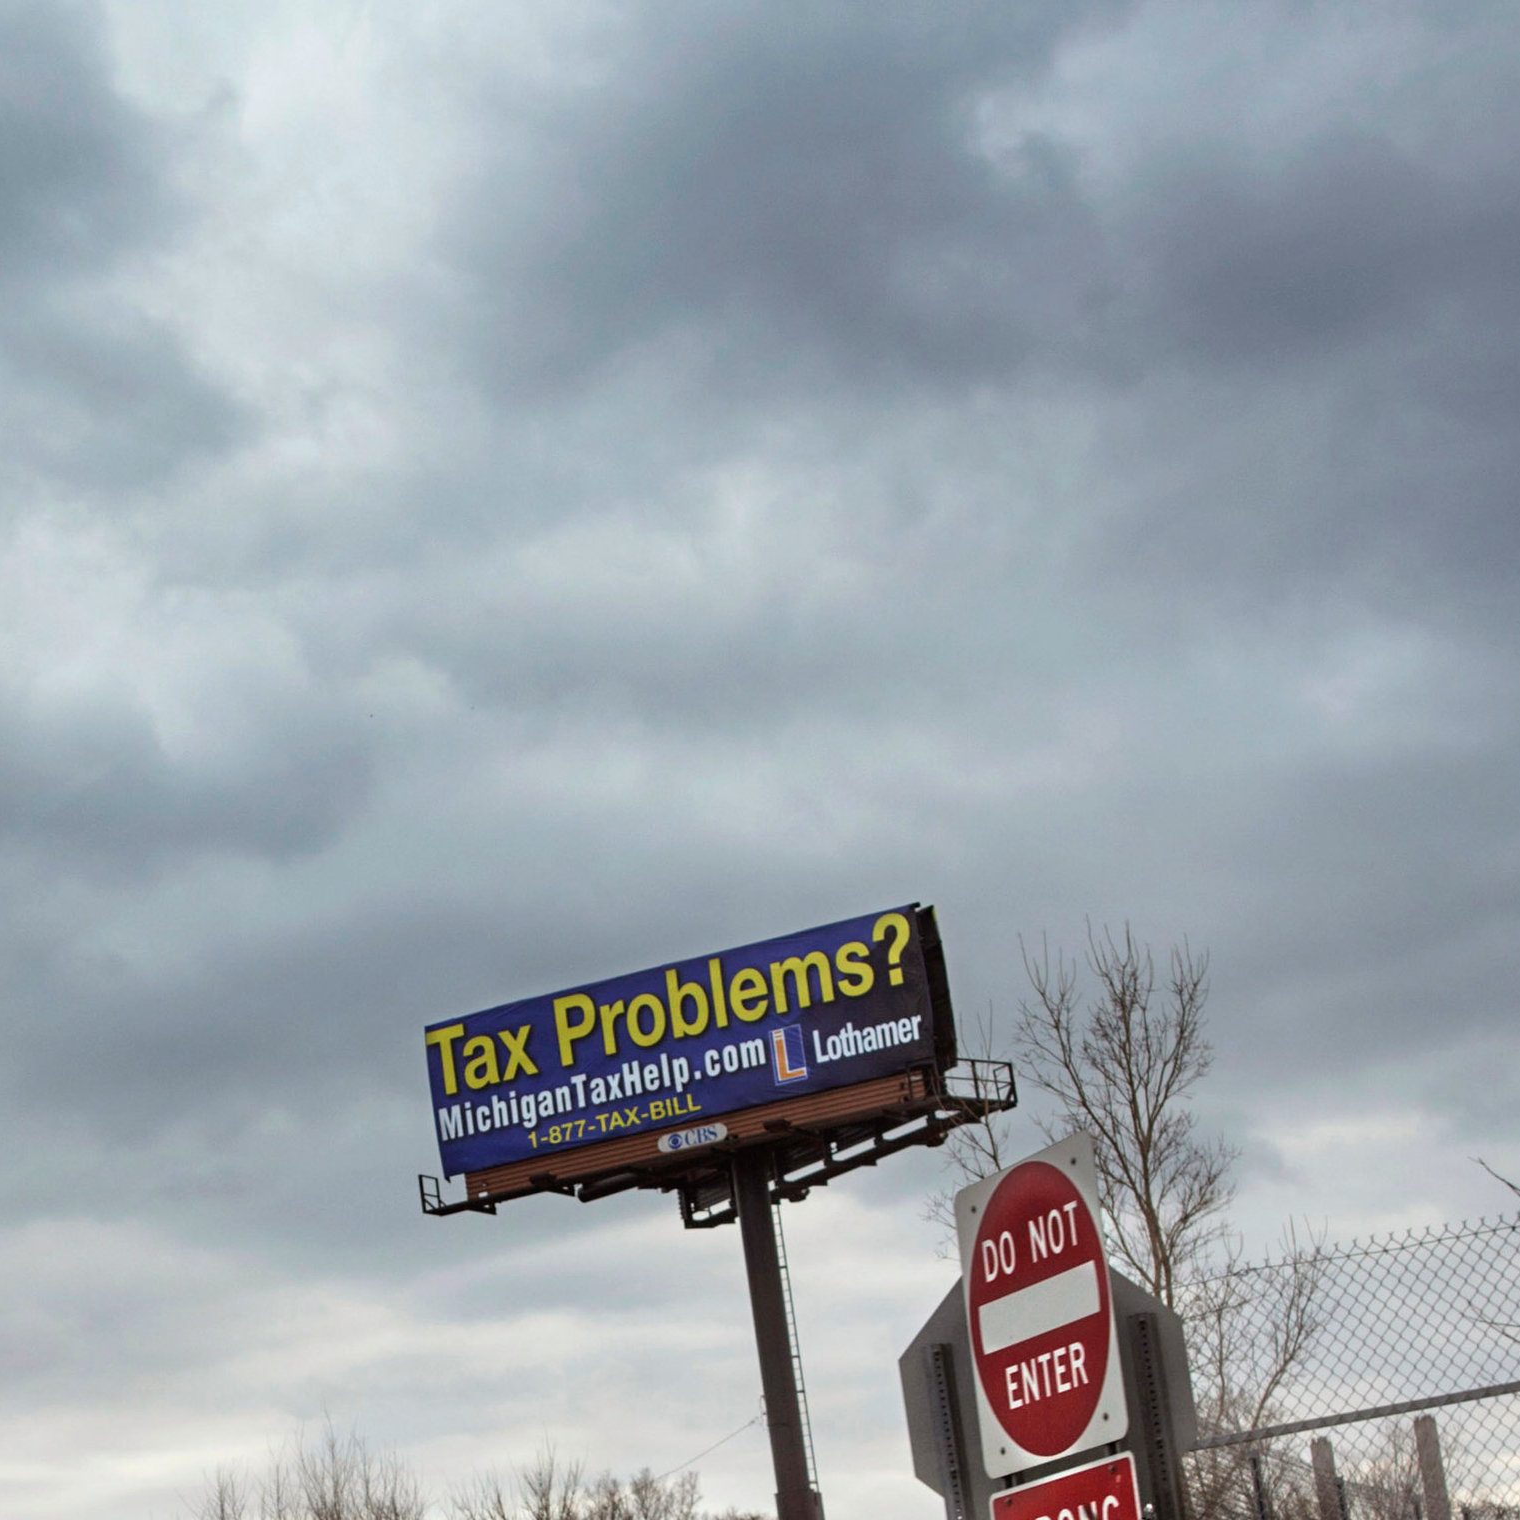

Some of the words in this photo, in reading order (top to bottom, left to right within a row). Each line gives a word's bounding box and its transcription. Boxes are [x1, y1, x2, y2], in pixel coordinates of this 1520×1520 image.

[425, 1023, 539, 1096] Tax
[552, 912, 911, 1067] Problems?
[812, 1014, 922, 1064] Lothamer
[437, 1037, 767, 1142] MichiganTaxHelp.com
[527, 1093, 702, 1148] 1-877-TAX-BILL
[684, 1126, 719, 1147] CBS
[981, 1230, 1016, 1283] DO
[1028, 1200, 1078, 1263] NOT
[1005, 1341, 1089, 1410] ENTER
